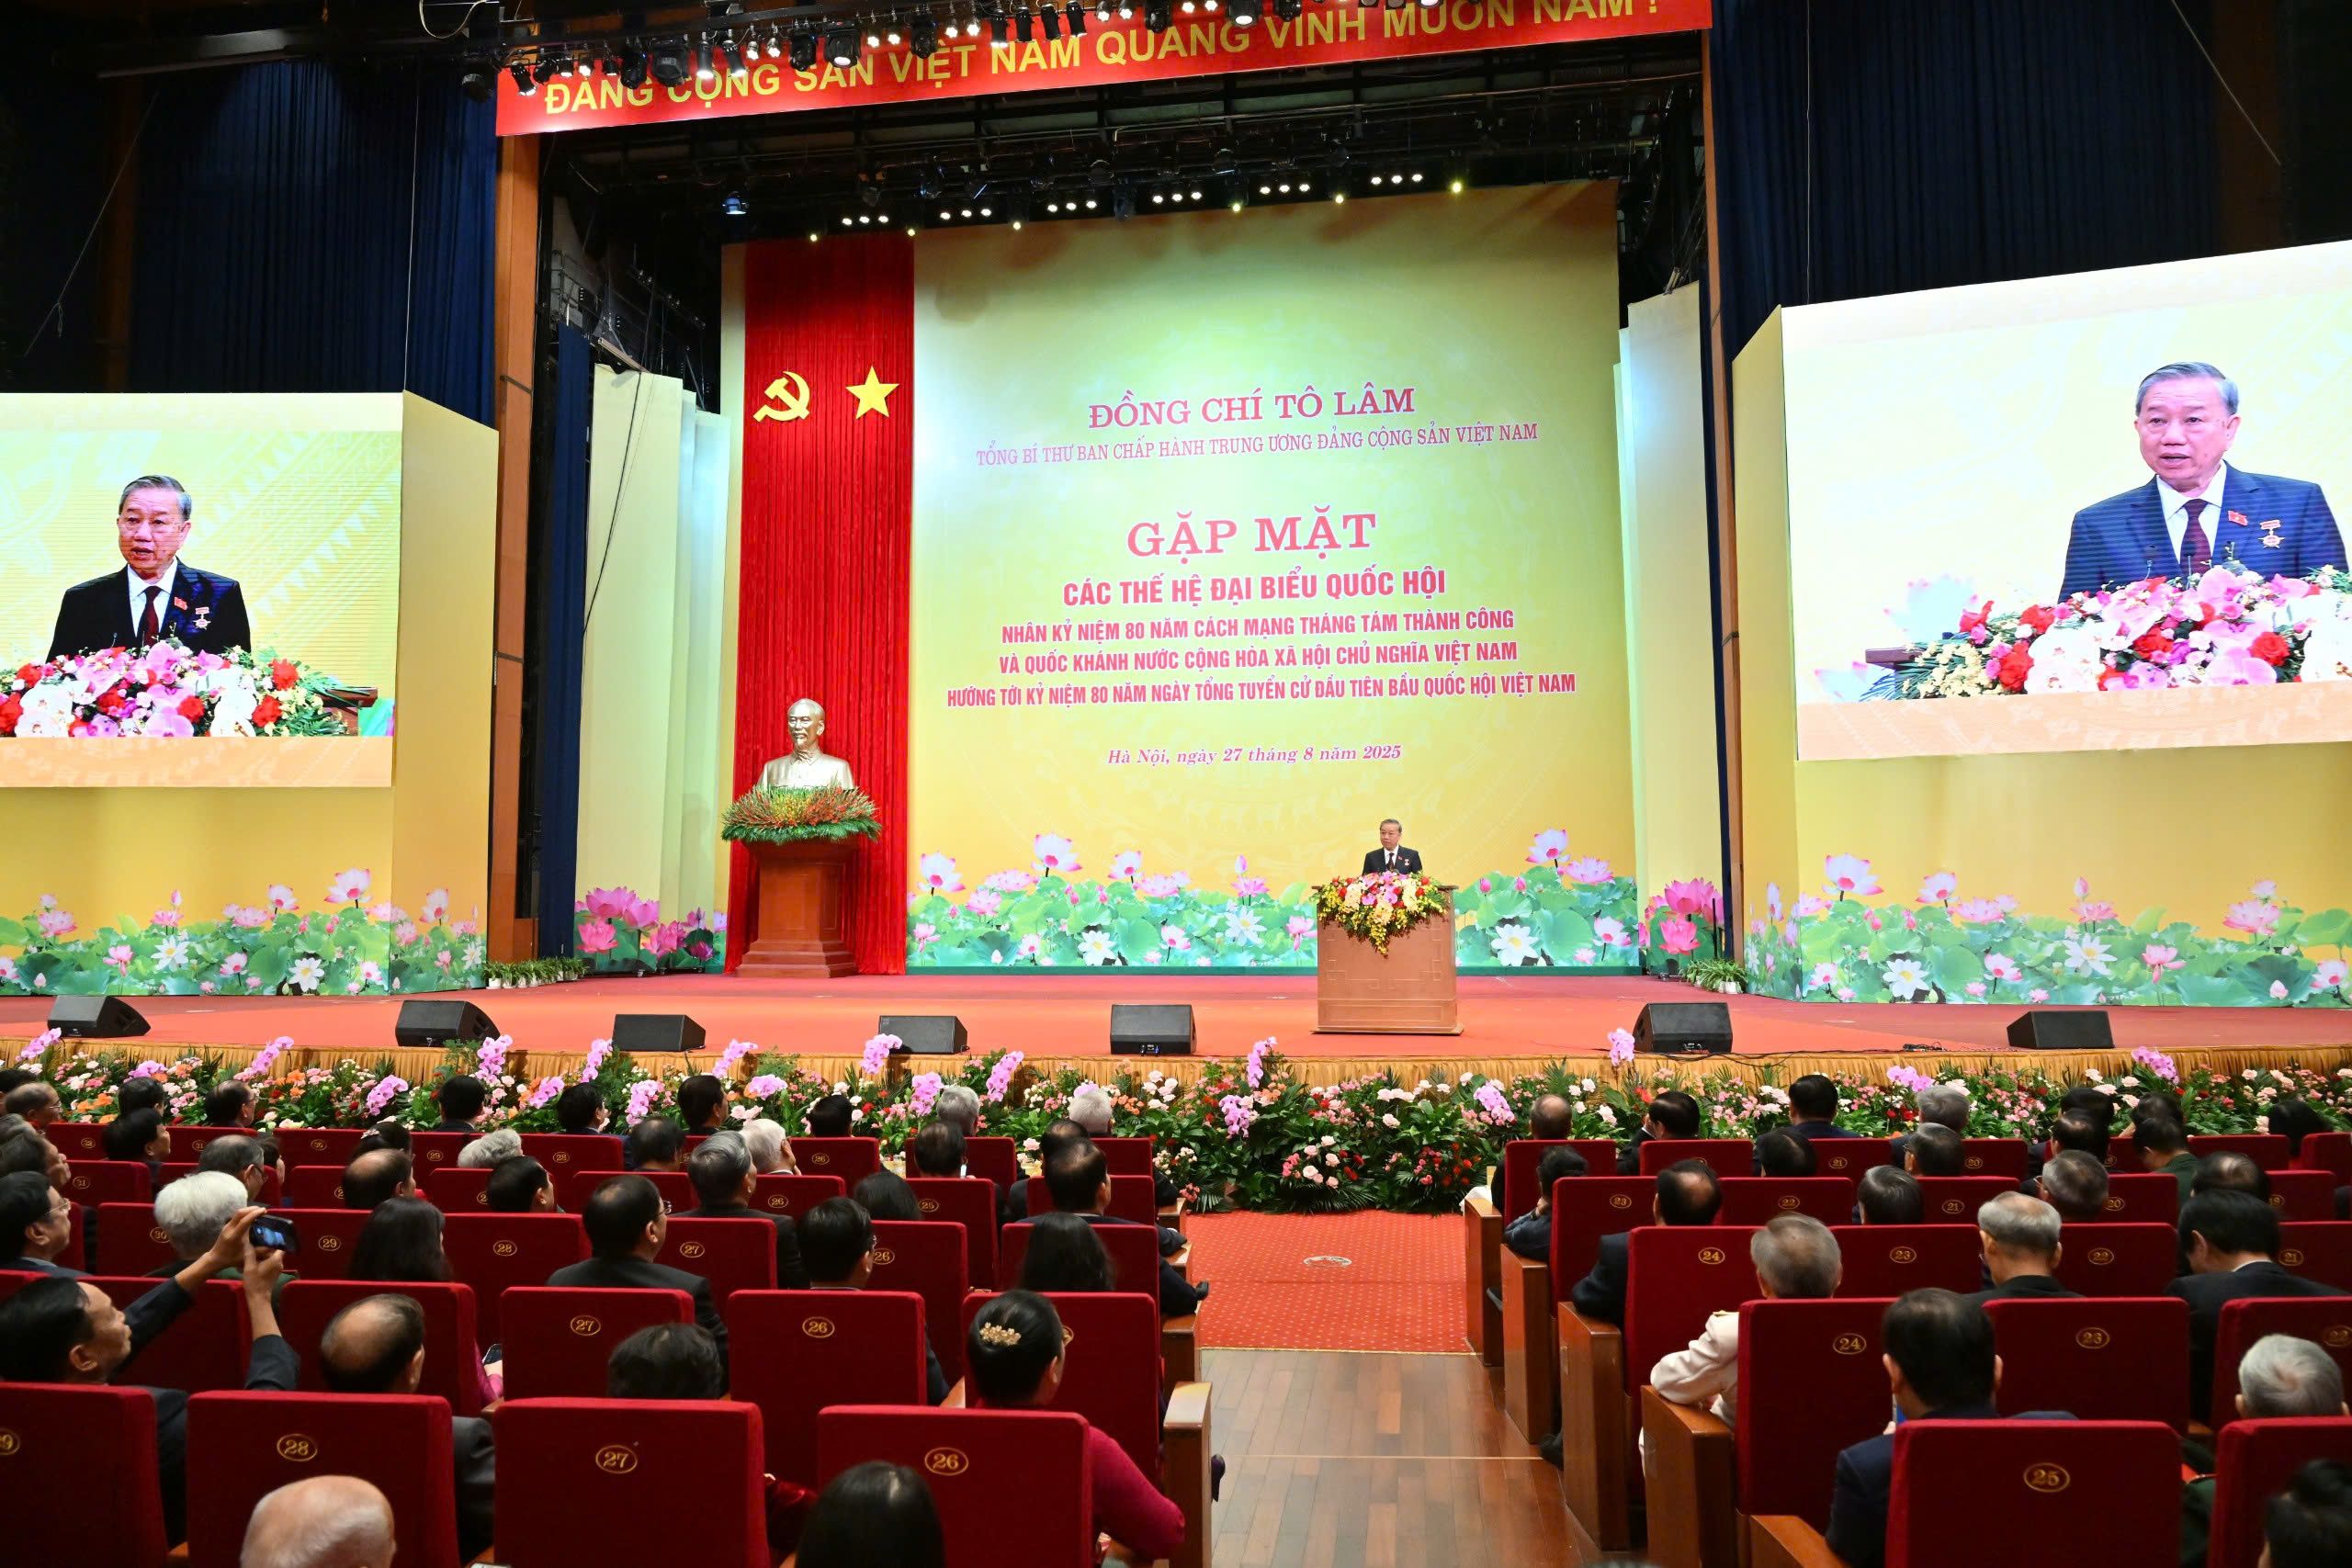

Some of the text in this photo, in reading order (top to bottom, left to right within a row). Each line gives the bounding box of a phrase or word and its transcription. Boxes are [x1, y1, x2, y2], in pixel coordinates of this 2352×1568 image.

[991, 36, 1080, 74] NAM
[1096, 21, 1250, 66] QUANG
[1264, 7, 1365, 49] VINH
[1089, 381, 1417, 429] ĐỒNG CHÍ TÔ LÂM
[977, 421, 1539, 466] TỔNG BÍ THƯ BAN CHẤP HÀNH TRUNG ƯƠNG ĐẢNG CỘNG SẢN VIỆT NAM
[1126, 504, 1378, 565] GẶP MẶT
[1062, 562, 1447, 608] CÁC THẾ HỆ ĐẠI BIỂU QUỐC HỘI
[1001, 605, 1515, 645] NHÂN KỶ NIỆM 80 NĂM CÁCH MẠNG THÁNG TÁM THÀNH CÔNG
[999, 638, 1519, 675] VÀ QUỐC KHÁNH NƯỚC CỘNG HÒA XÃ HỘI CHỦ NGHĨA VIỆT NAM
[947, 671, 1577, 709] HƯỚNG TỚI KỶ NIỆM 80 NĂM NGÀY TỔNG TUYỂN CỬ ĐẦU TIÊN BẦU QUỐC HỘI VIỆT NAM
[1107, 744, 1402, 767] Hà Nội, ngày 27 tháng 8 năm 2025
[575, 1319, 595, 1331] 27
[808, 1321, 828, 1334] 26
[1839, 1337, 1860, 1350] 24
[284, 1439, 309, 1455] 28
[603, 1451, 628, 1468] 27
[933, 1453, 959, 1470] 26
[2031, 1469, 2059, 1485] 25
